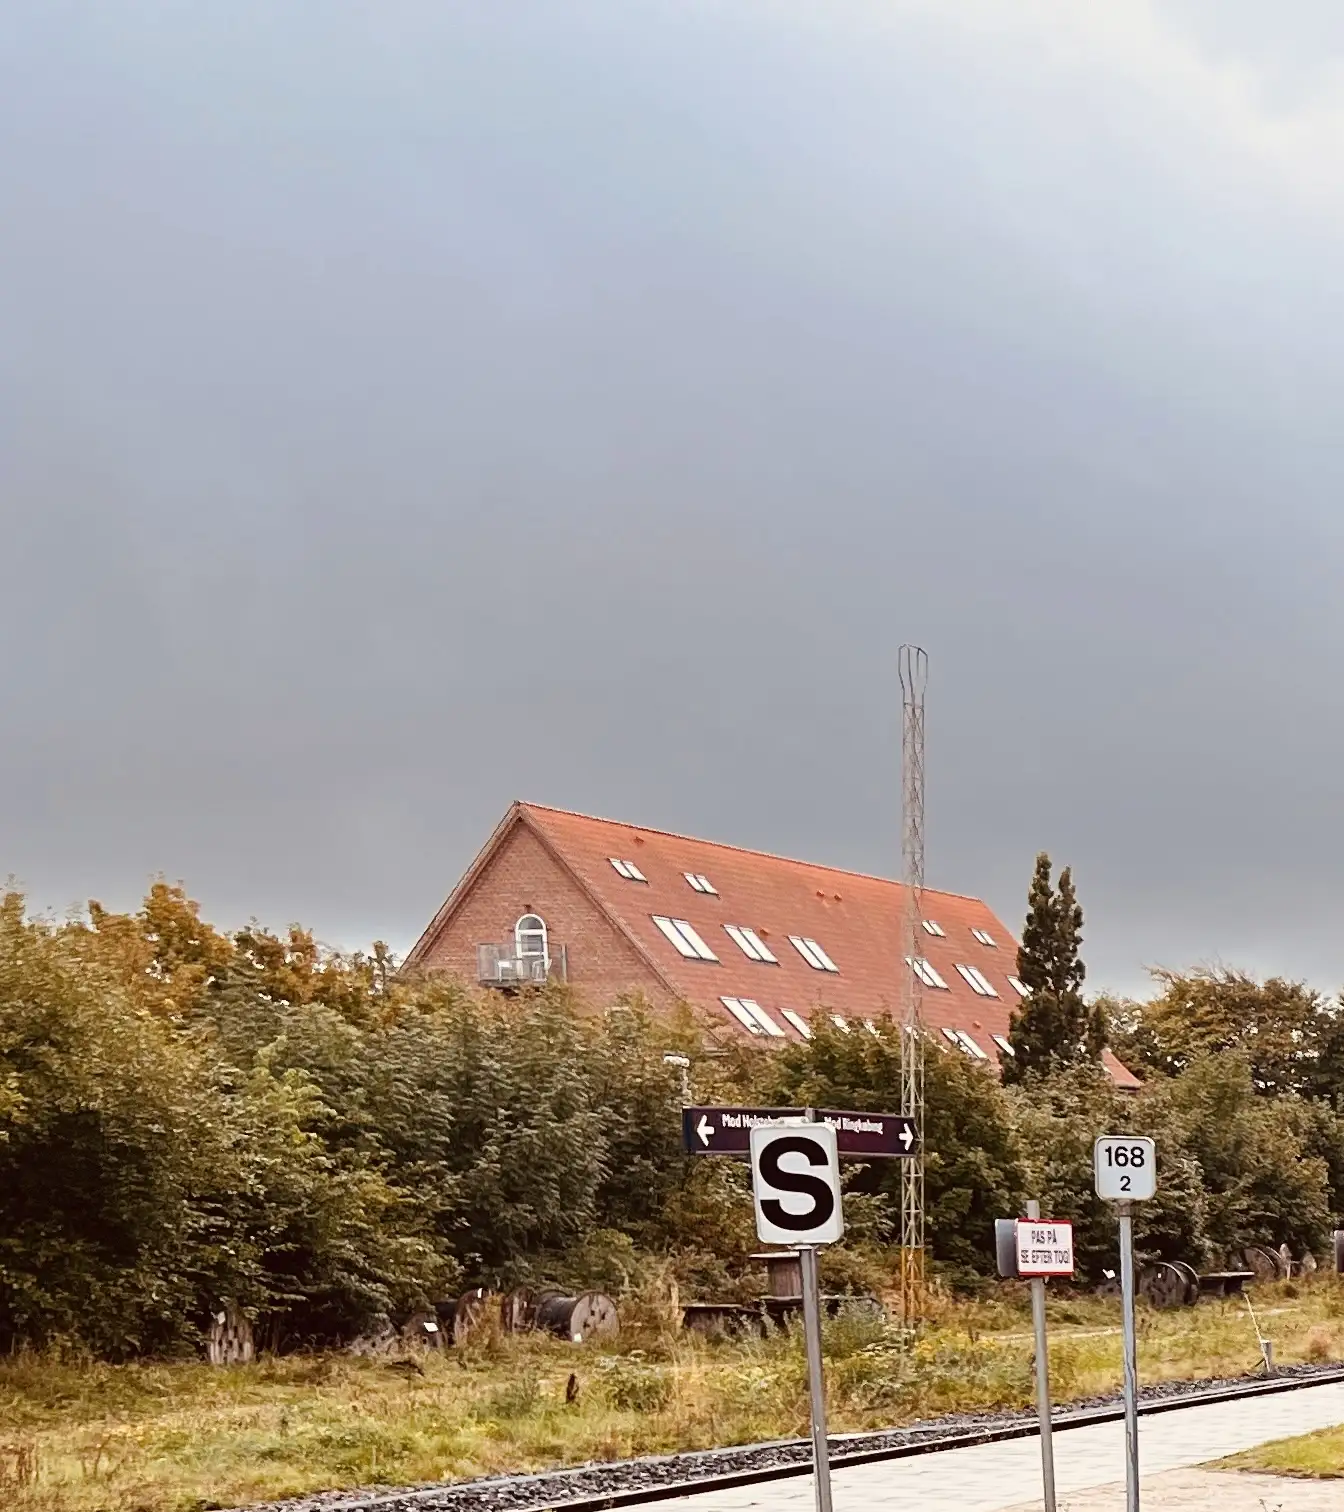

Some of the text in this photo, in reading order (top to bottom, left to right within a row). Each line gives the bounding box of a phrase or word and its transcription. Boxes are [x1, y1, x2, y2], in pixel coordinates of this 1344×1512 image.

[721, 1113, 741, 1128] Mod
[1104, 1145, 1145, 1168] 168
[759, 1136, 835, 1231] S
[1119, 1175, 1131, 1192] 2
